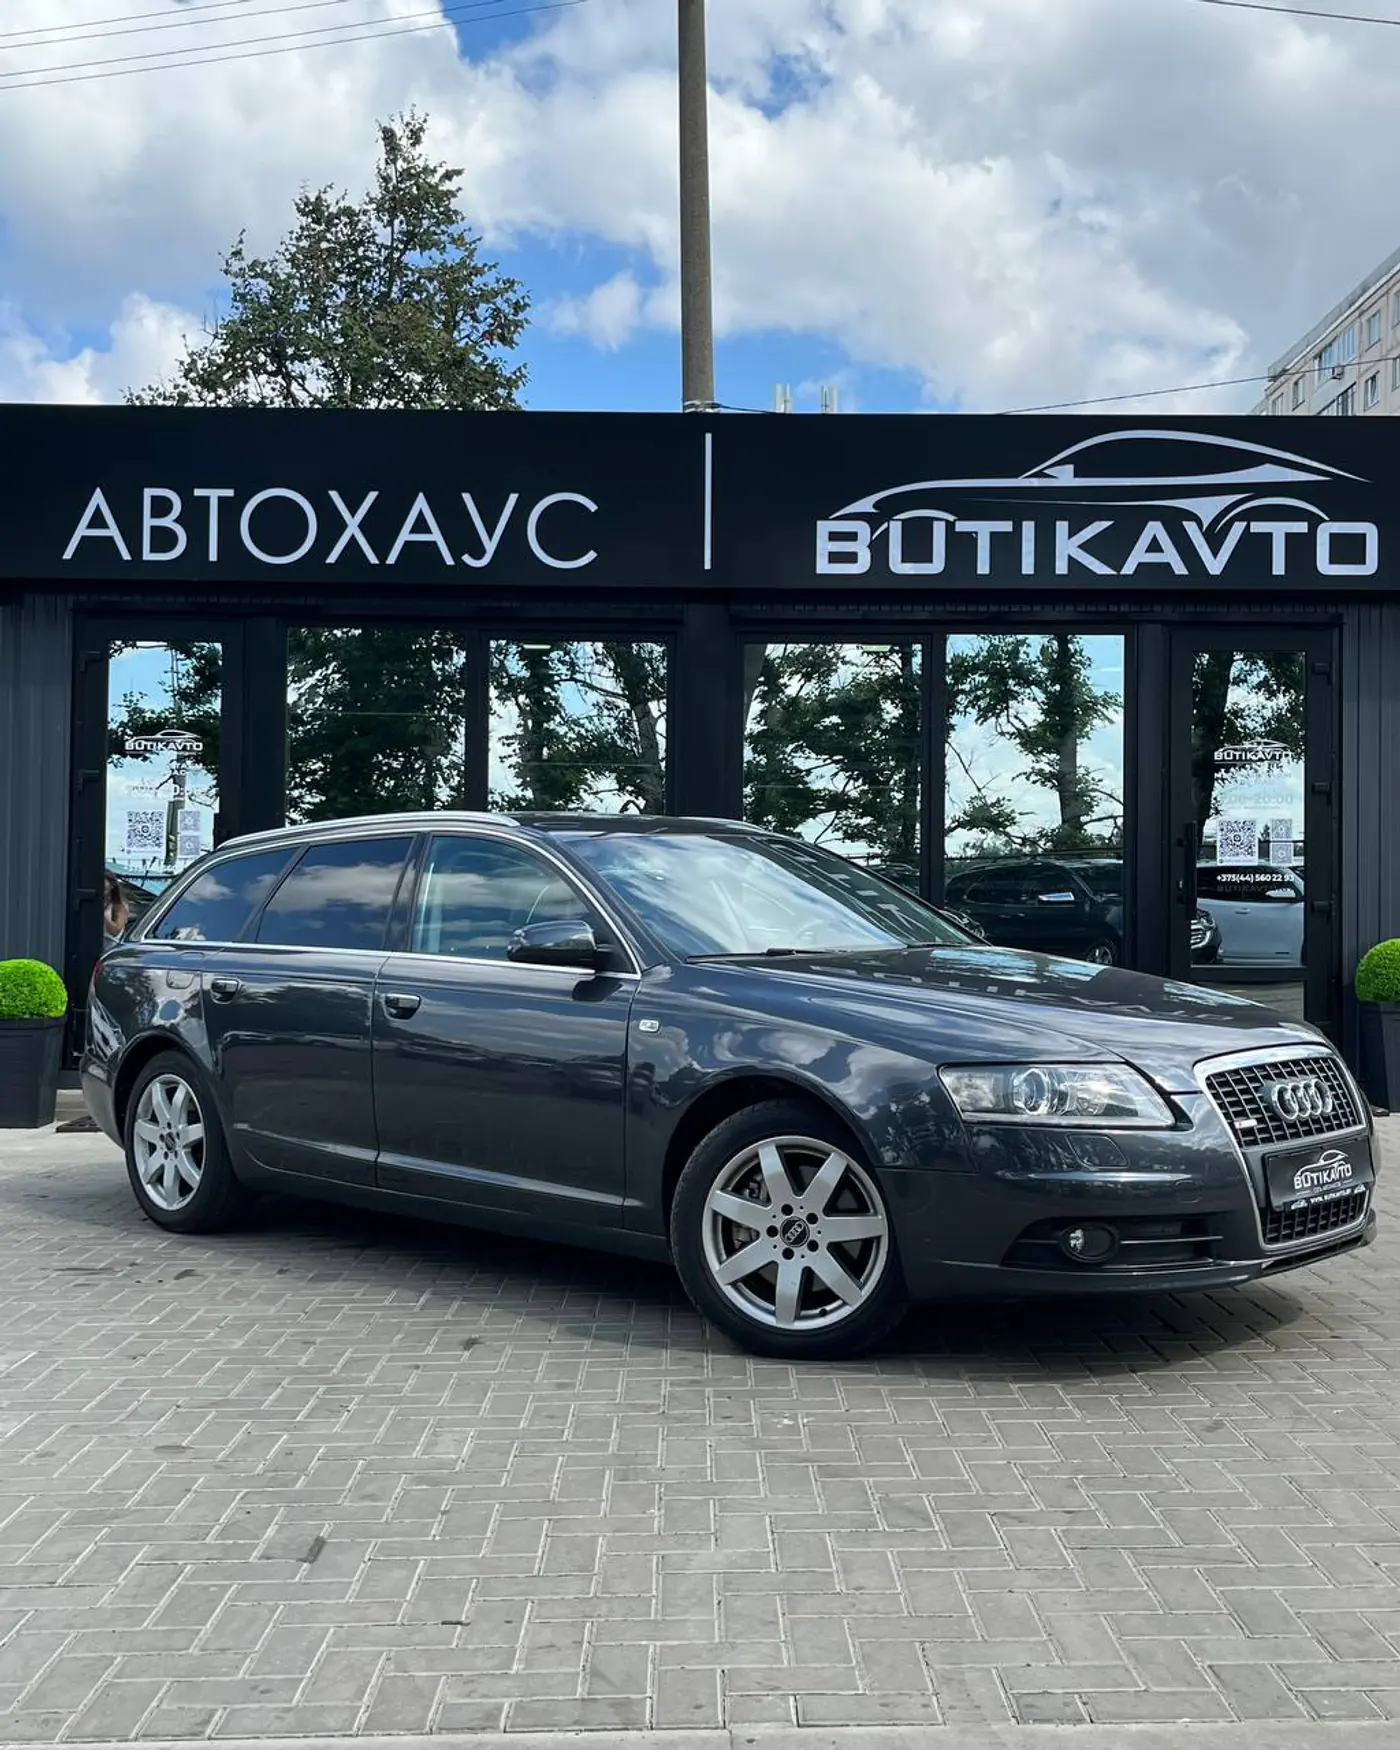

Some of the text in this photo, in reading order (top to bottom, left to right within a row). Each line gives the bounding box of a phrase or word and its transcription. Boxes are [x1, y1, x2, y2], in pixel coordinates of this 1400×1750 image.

[62, 486, 599, 569] АВТОХАУС
[815, 520, 1379, 575] BUTIKAVTO
[125, 741, 203, 751] BUTIKAVTO
[1213, 751, 1292, 761] BUTIKAVTO
[1272, 873, 1282, 882] 22
[1294, 1163, 1352, 1189] BUTIKAVTO
